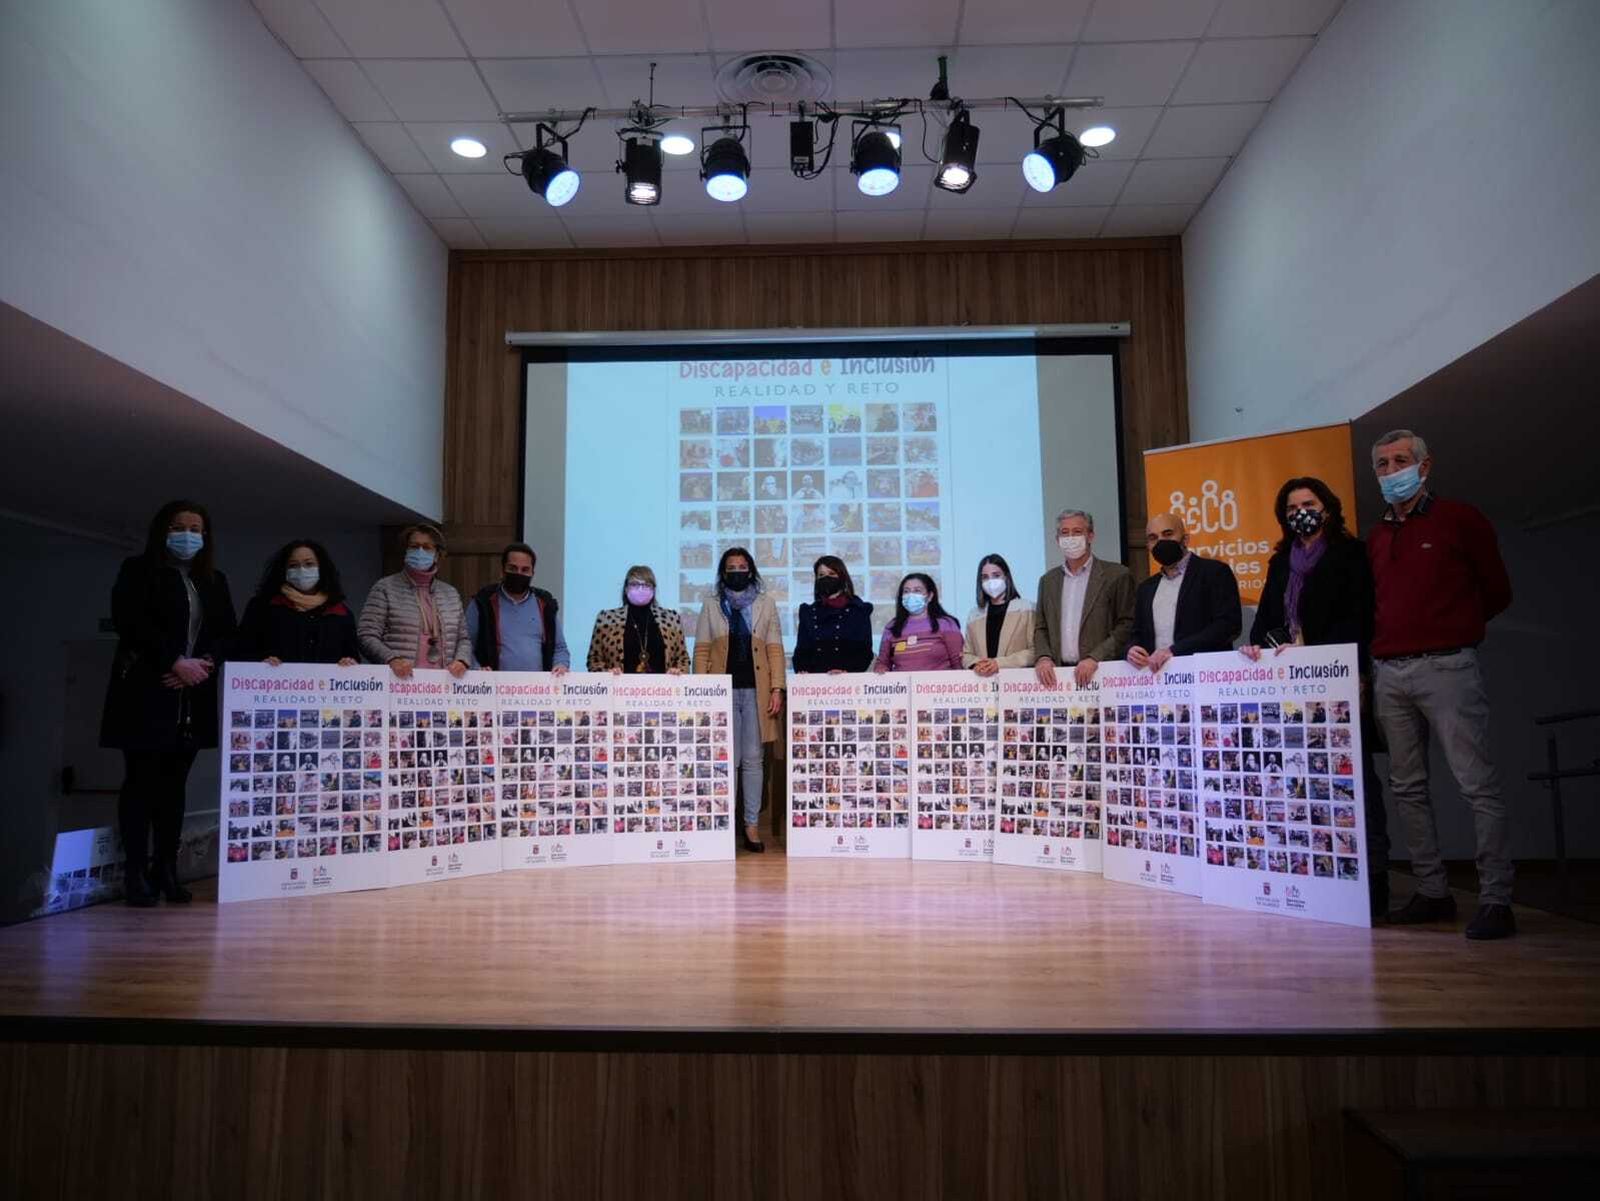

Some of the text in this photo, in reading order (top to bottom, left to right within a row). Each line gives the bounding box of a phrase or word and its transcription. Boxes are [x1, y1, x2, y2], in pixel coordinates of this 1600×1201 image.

[679, 359, 814, 381] Discapacidad
[820, 360, 831, 375] e
[715, 382, 899, 397] REALIDAD Y RETO
[1200, 660, 1349, 684] Discapacidad e Inclusión
[232, 676, 383, 692] Discapacidad e Inclusión
[1103, 674, 1153, 688] Discapacidad
[1163, 671, 1195, 685] Inclusi
[389, 682, 441, 695] scapacidad
[453, 681, 492, 694] Inclusión
[563, 682, 607, 695] Inclusión
[684, 684, 727, 696] Inclusión
[792, 685, 852, 697] Discapacidad
[864, 682, 907, 695] Inclusión
[916, 683, 979, 696] Discapacidad
[1116, 690, 1155, 699] REALIDAD
[1168, 689, 1190, 698] RETO
[1219, 684, 1327, 696] REALIDAD Y RETO
[254, 695, 363, 704] REALIDAD Y RETO
[501, 698, 551, 706] REALIDAD
[1020, 696, 1066, 704] REALIDAD
